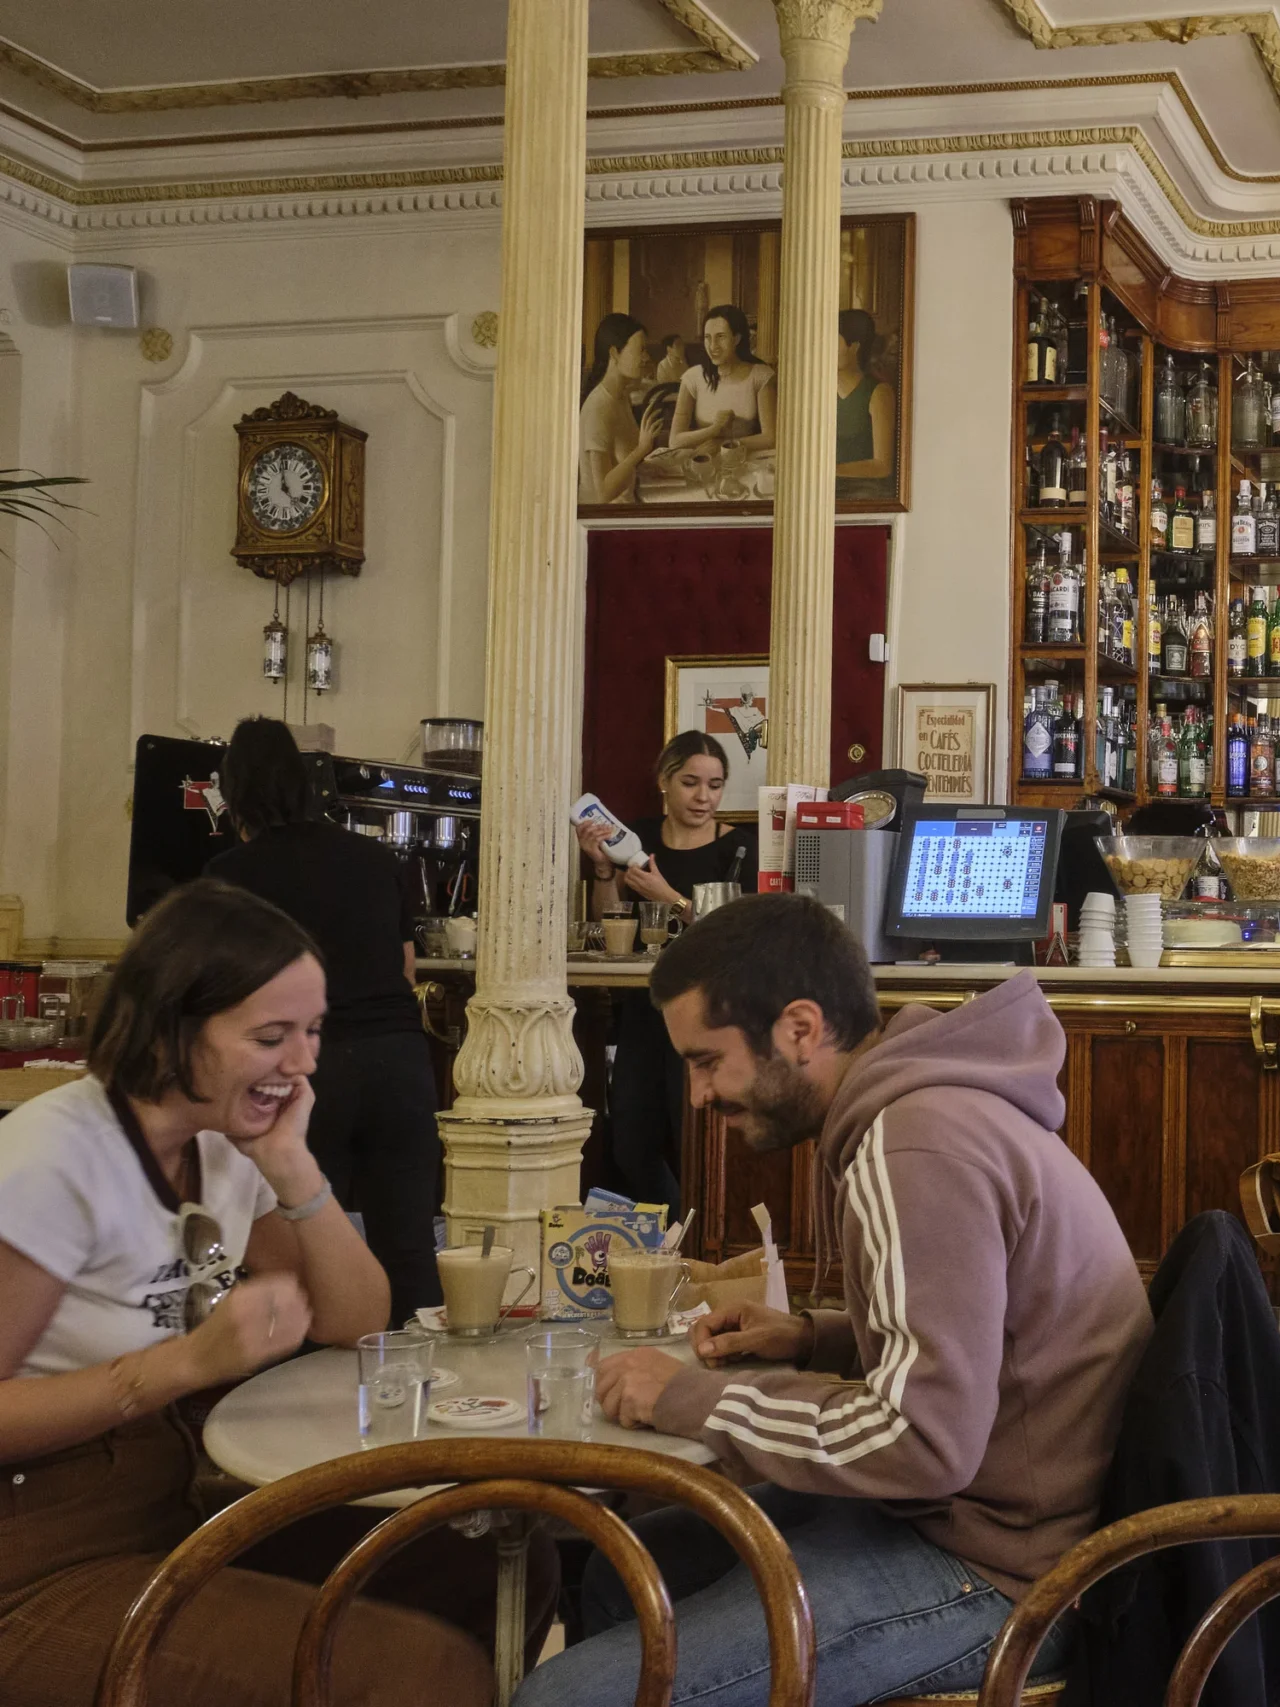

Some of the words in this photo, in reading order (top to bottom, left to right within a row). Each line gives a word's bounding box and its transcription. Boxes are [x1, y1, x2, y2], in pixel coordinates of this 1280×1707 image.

[927, 714, 965, 727] Especialidad
[919, 732, 928, 741] en
[930, 729, 960, 751] CAFÉS
[918, 751, 972, 772] COCTELERÍA
[923, 772, 972, 793] ENTEMPIÉS
